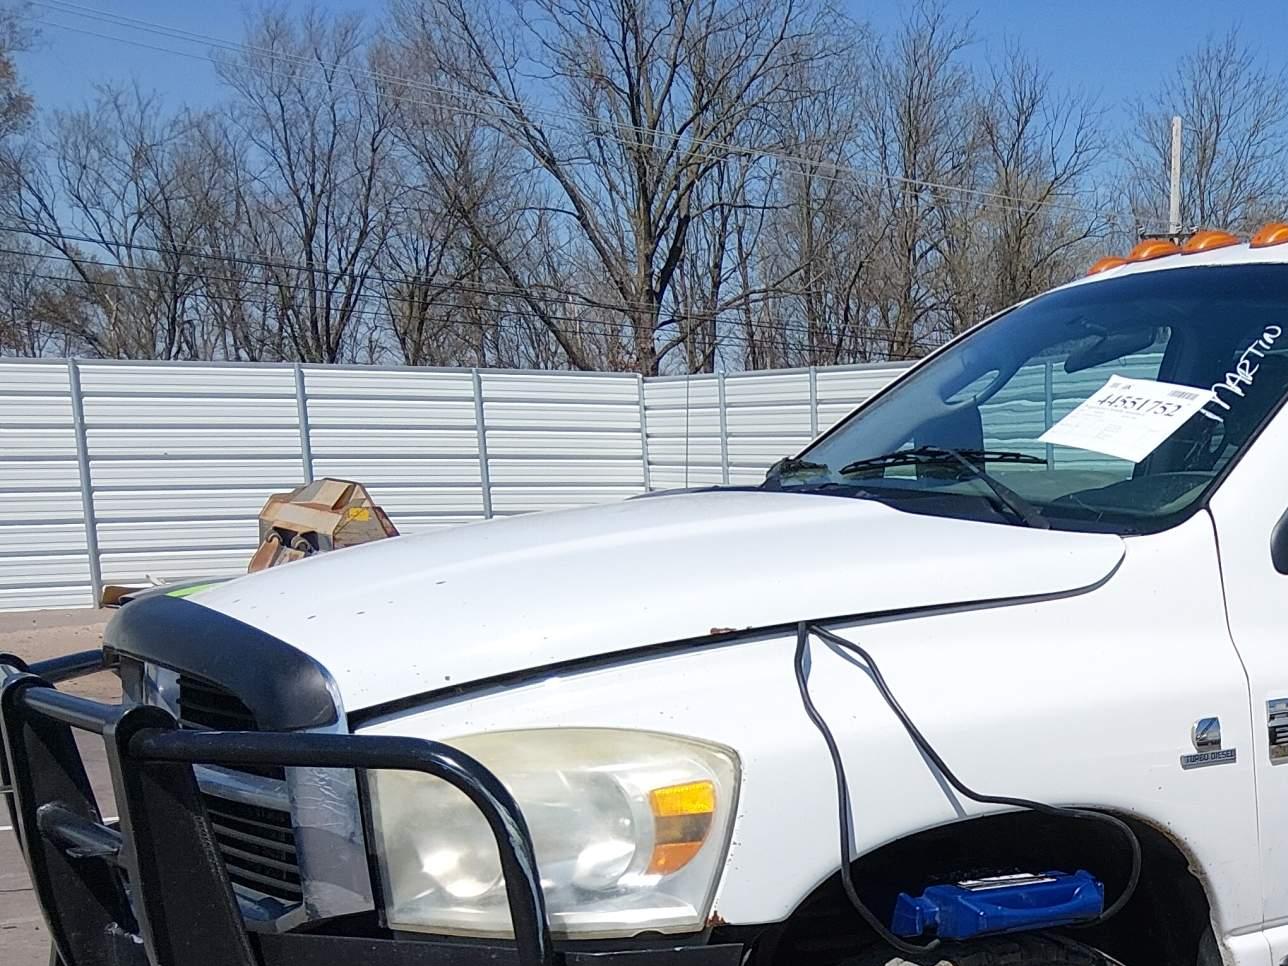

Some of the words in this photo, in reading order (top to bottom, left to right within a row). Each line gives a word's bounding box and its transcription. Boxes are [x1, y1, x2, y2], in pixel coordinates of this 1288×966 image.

[1200, 325, 1282, 422] MARTIN
[1097, 393, 1183, 417] 44551752
[1186, 752, 1209, 763] TURBO
[1210, 749, 1234, 760] DIESEL
